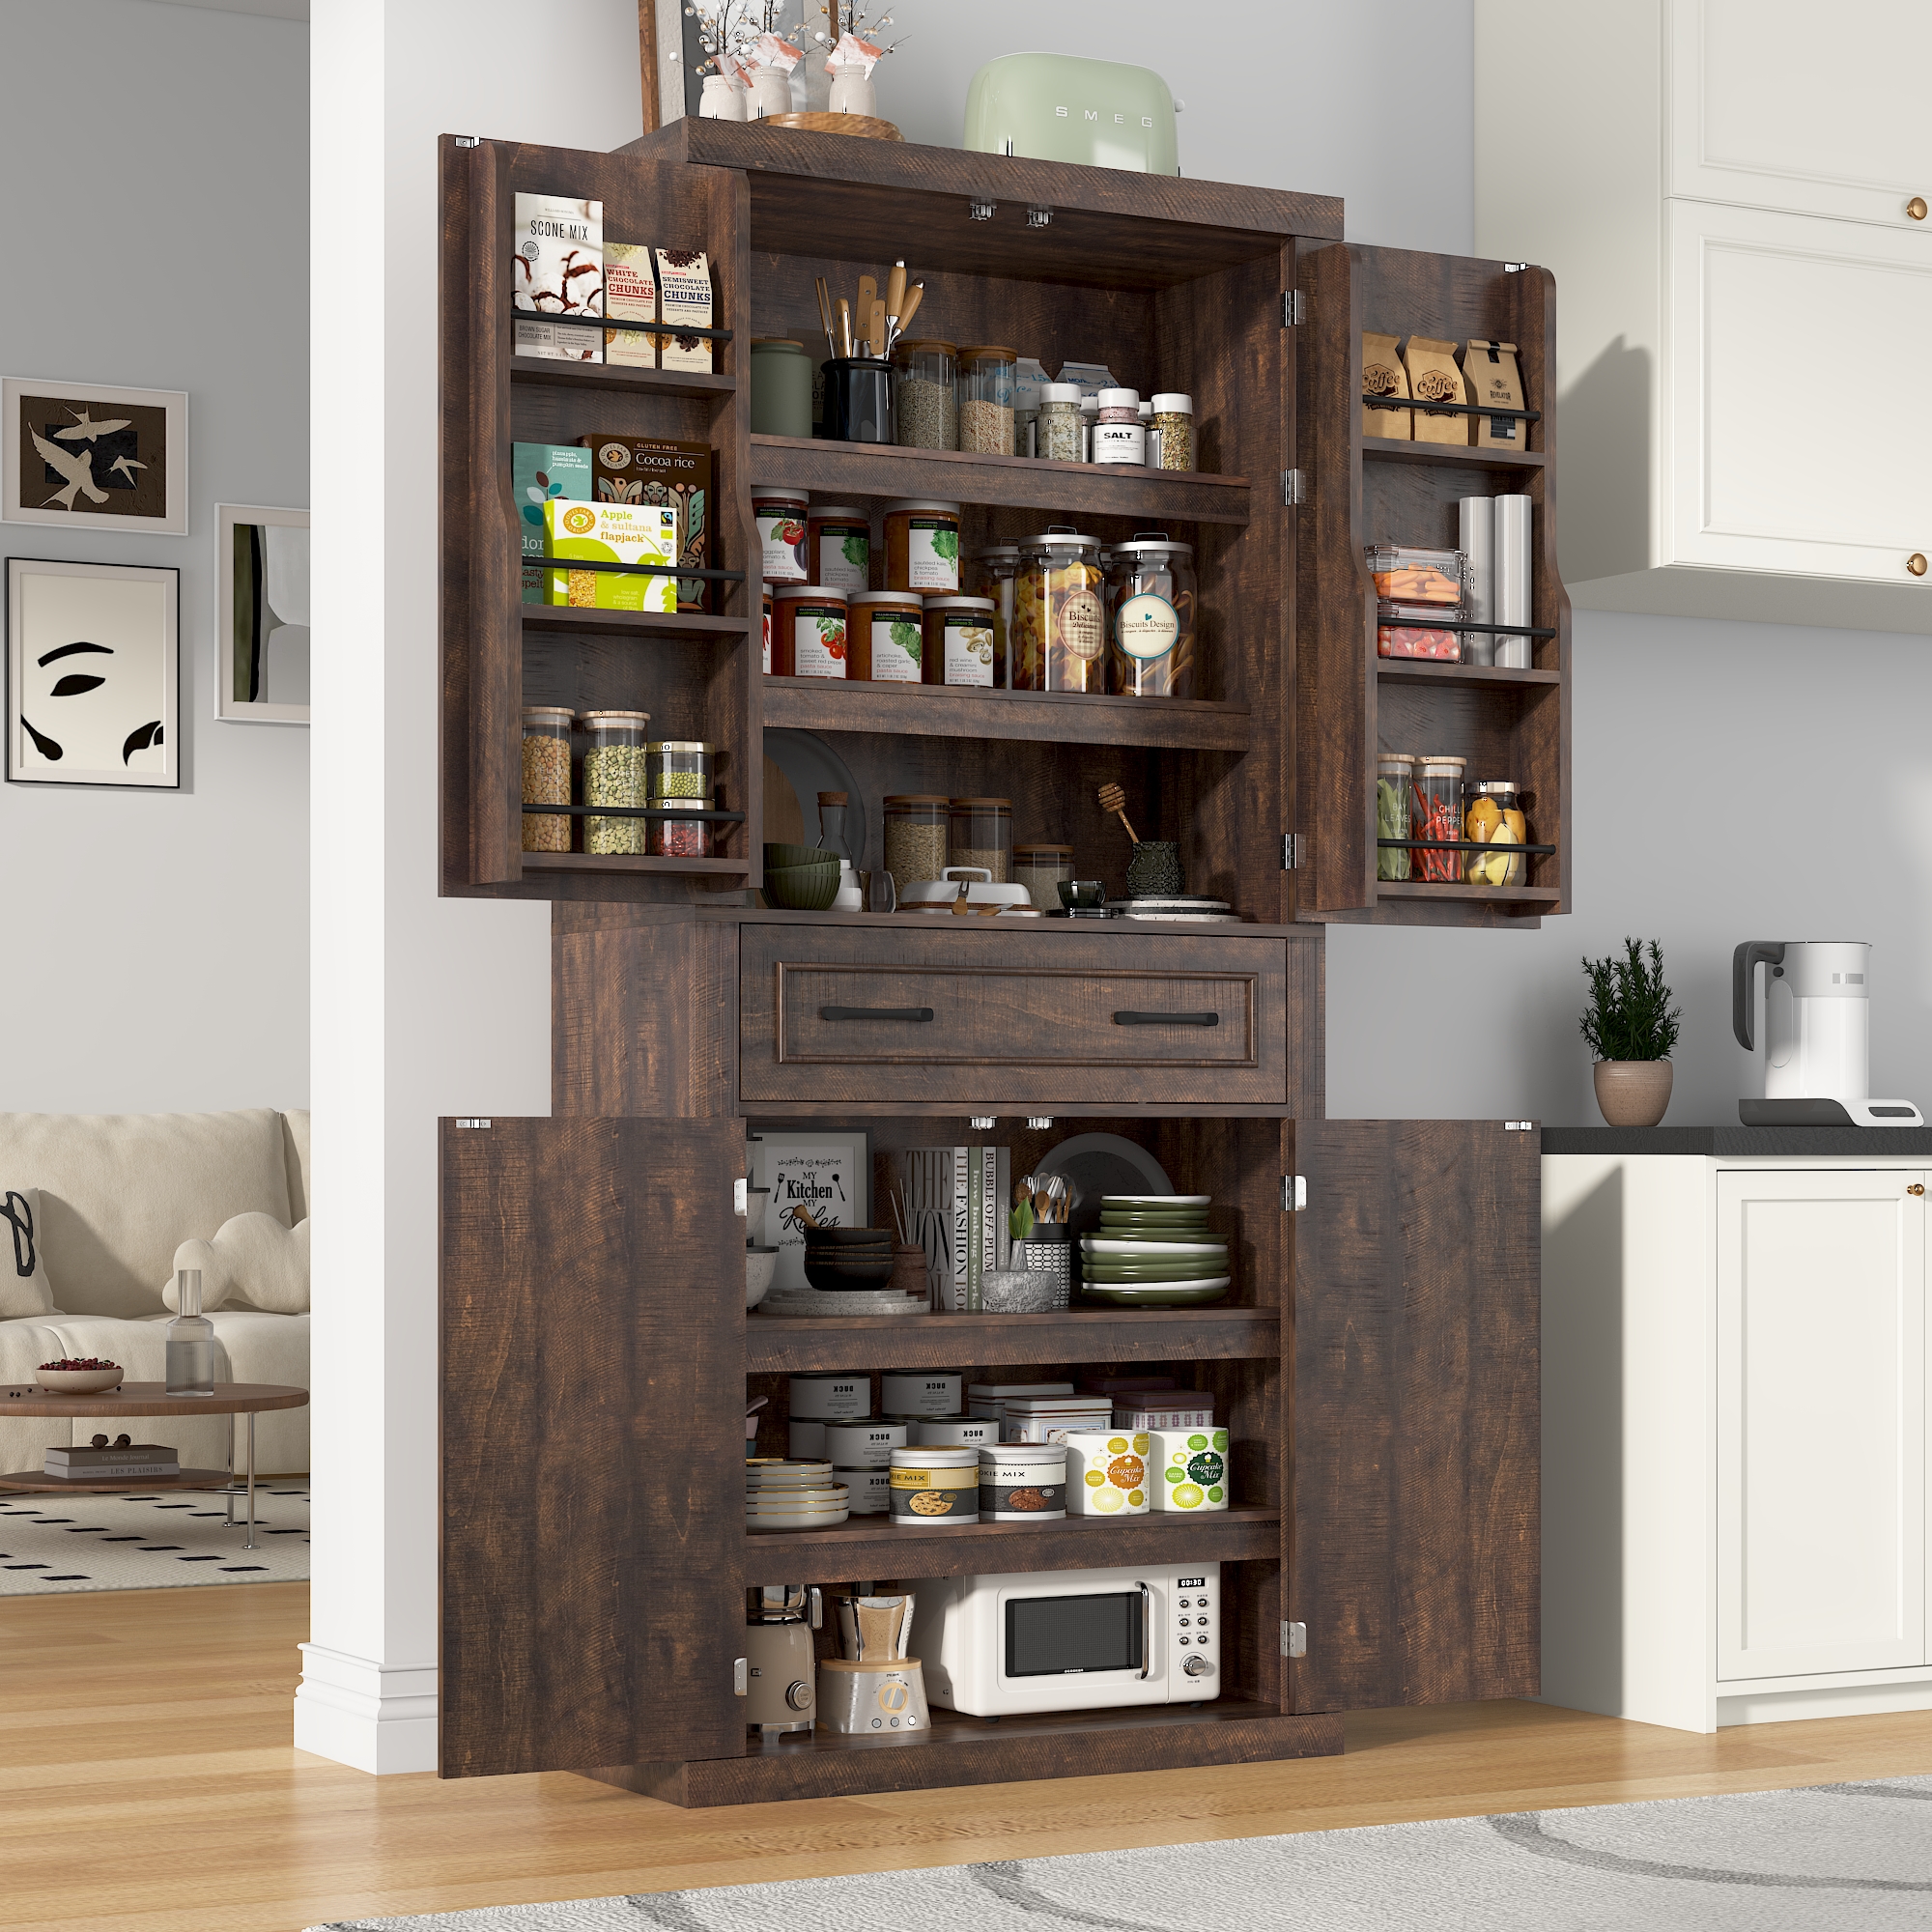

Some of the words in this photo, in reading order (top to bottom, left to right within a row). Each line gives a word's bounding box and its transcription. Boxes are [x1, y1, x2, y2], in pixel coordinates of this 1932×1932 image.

[1056, 106, 1152, 128] SMEG
[531, 220, 564, 238] SCONE
[570, 225, 587, 241] MIX
[607, 269, 638, 277] WHITE
[609, 276, 653, 286] CHOCOLATE
[663, 276, 709, 285] SEMISWEET
[609, 284, 653, 296] CHUNKS
[665, 290, 710, 301] CHUNKS
[1362, 371, 1401, 388] Coffee
[1417, 377, 1458, 395] Coffee
[636, 452, 671, 467] Cocoa
[674, 457, 695, 469] rice
[565, 508, 579, 524] DOVES
[580, 508, 593, 522] FARM
[601, 510, 633, 521] Apple
[568, 523, 593, 533] ORGANIC
[600, 521, 609, 529] &
[612, 523, 652, 532] sultana
[601, 531, 644, 543] flapjack
[1069, 611, 1101, 622] Biscuits
[1150, 620, 1175, 629] Design
[956, 1151, 967, 1190] THE
[906, 1150, 952, 1209] THE
[985, 1152, 994, 1202] BUBBLE
[787, 1180, 833, 1198] Kitchen
[955, 1195, 967, 1276] FASHION
[971, 1206, 980, 1259] baking
[955, 1282, 966, 1310] BO
[1110, 1466, 1143, 1476] Cupcake
[1190, 1463, 1222, 1472] Cupcake
[1121, 1474, 1140, 1483] Mix
[1201, 1470, 1219, 1480] Mix
